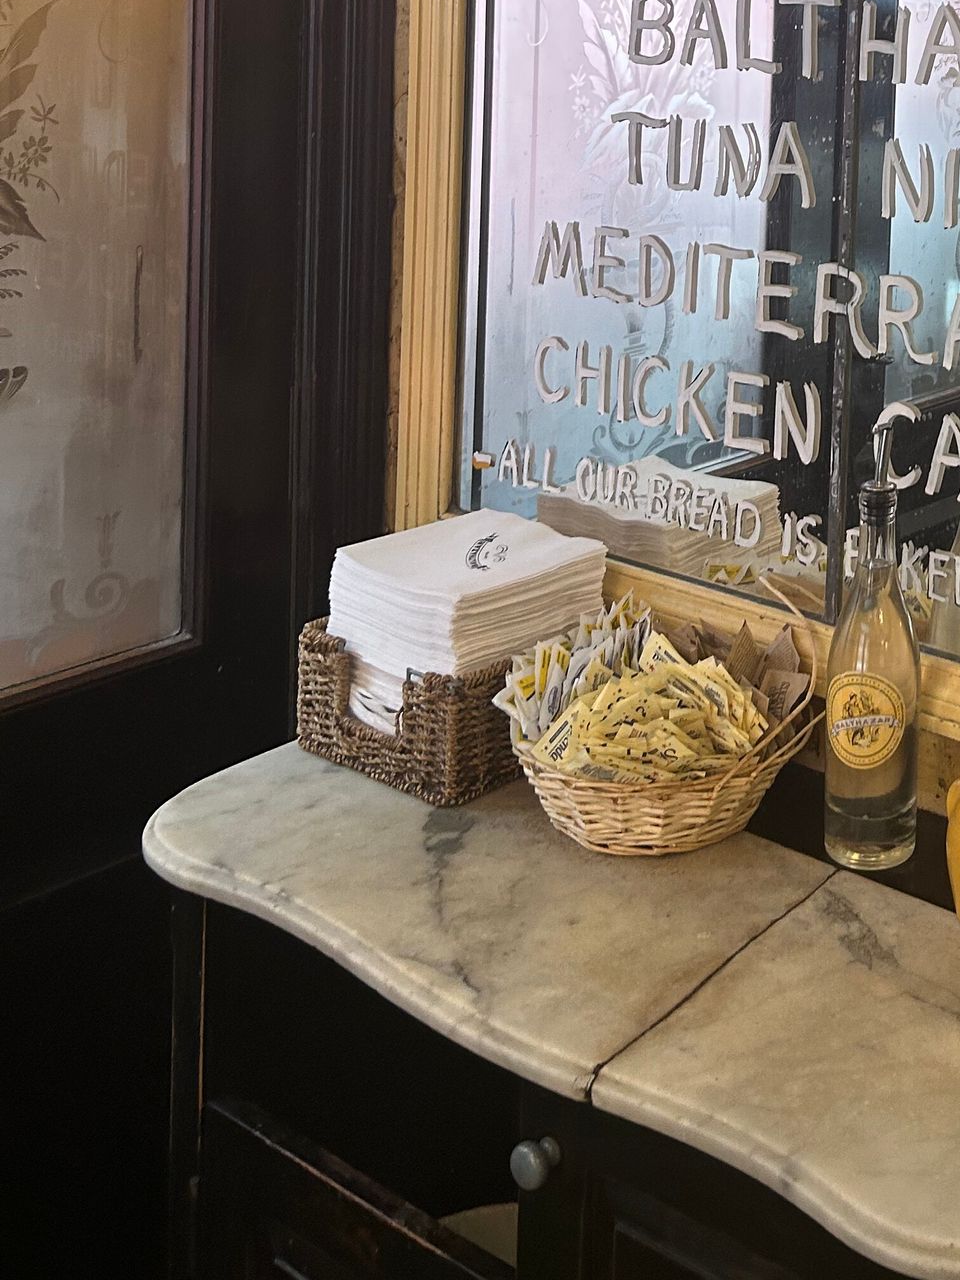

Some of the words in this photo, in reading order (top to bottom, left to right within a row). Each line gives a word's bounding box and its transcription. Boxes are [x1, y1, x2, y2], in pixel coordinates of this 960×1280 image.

[611, 112, 817, 208] TUNA
[534, 336, 821, 466] CHICKEN
[576, 456, 640, 510] OUR
[647, 473, 764, 547] BREAD
[782, 512, 823, 566] IS
